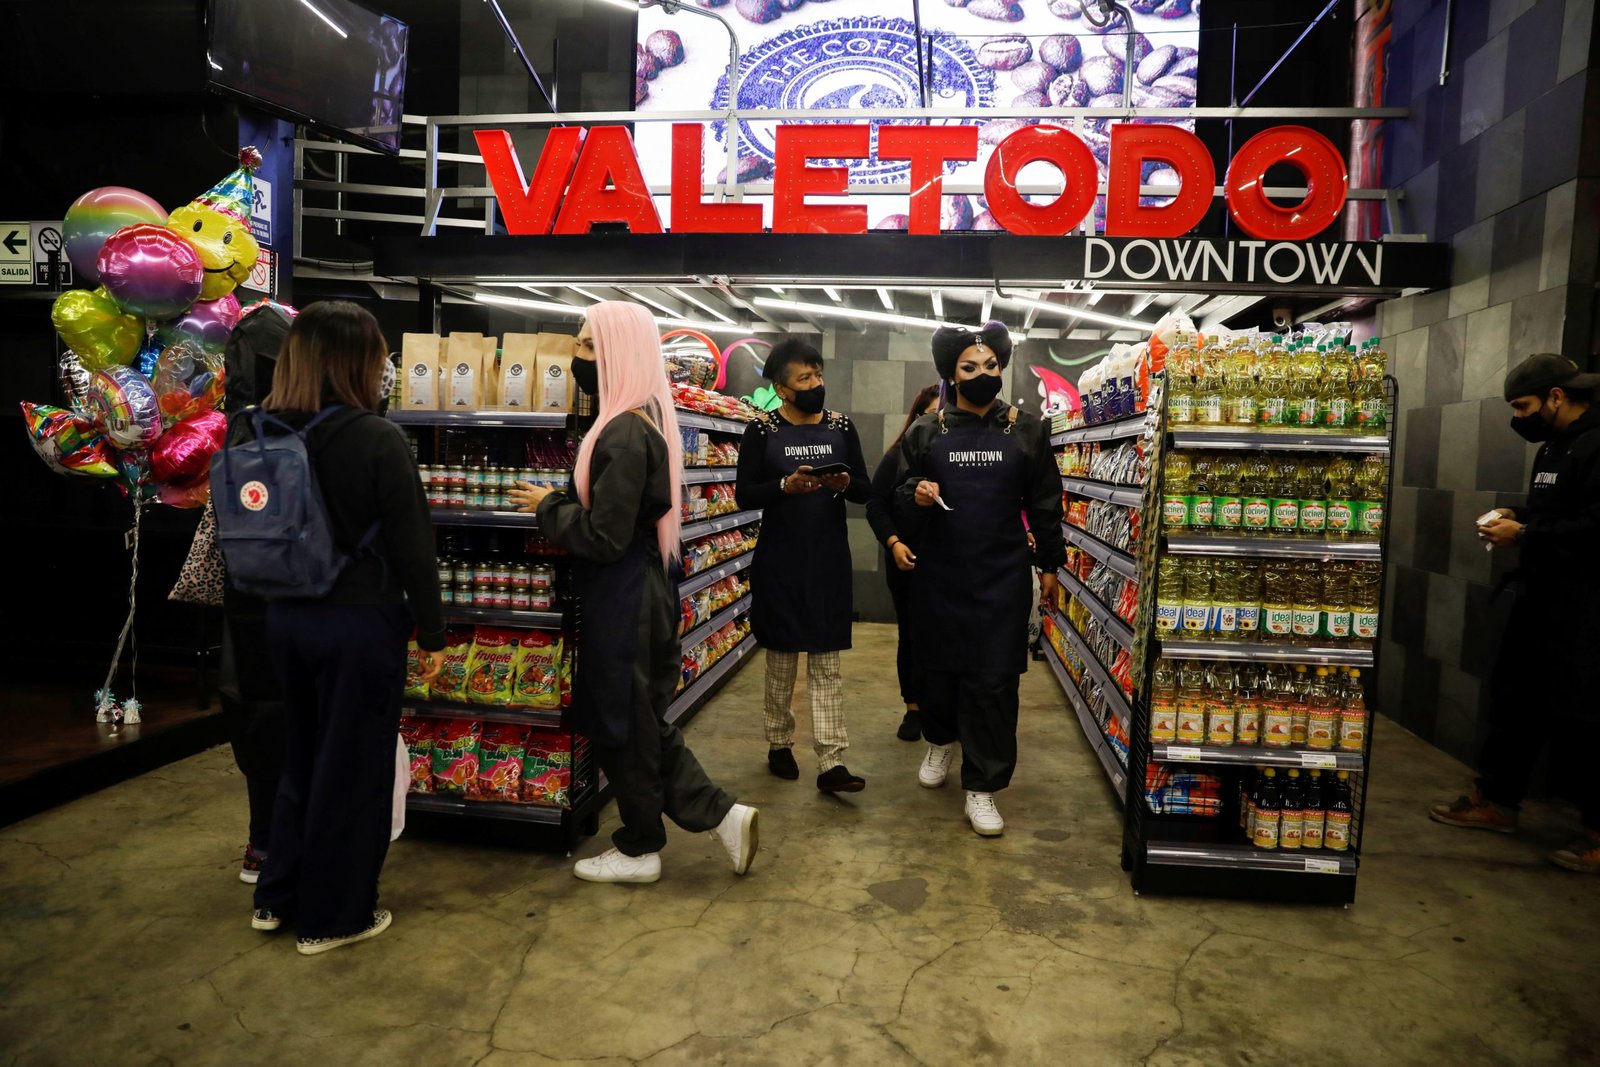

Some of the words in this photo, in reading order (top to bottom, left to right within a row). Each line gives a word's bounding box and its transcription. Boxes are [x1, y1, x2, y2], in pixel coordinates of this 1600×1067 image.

[758, 47, 818, 87] THE
[821, 38, 945, 76] COFFEE
[1083, 237, 1383, 286] DOWNTOWN
[1, 268, 30, 276] SALIDA
[1185, 606, 1206, 618] ideal
[1294, 611, 1315, 623] ideal
[1333, 614, 1350, 625] idea
[1359, 615, 1378, 626] idea
